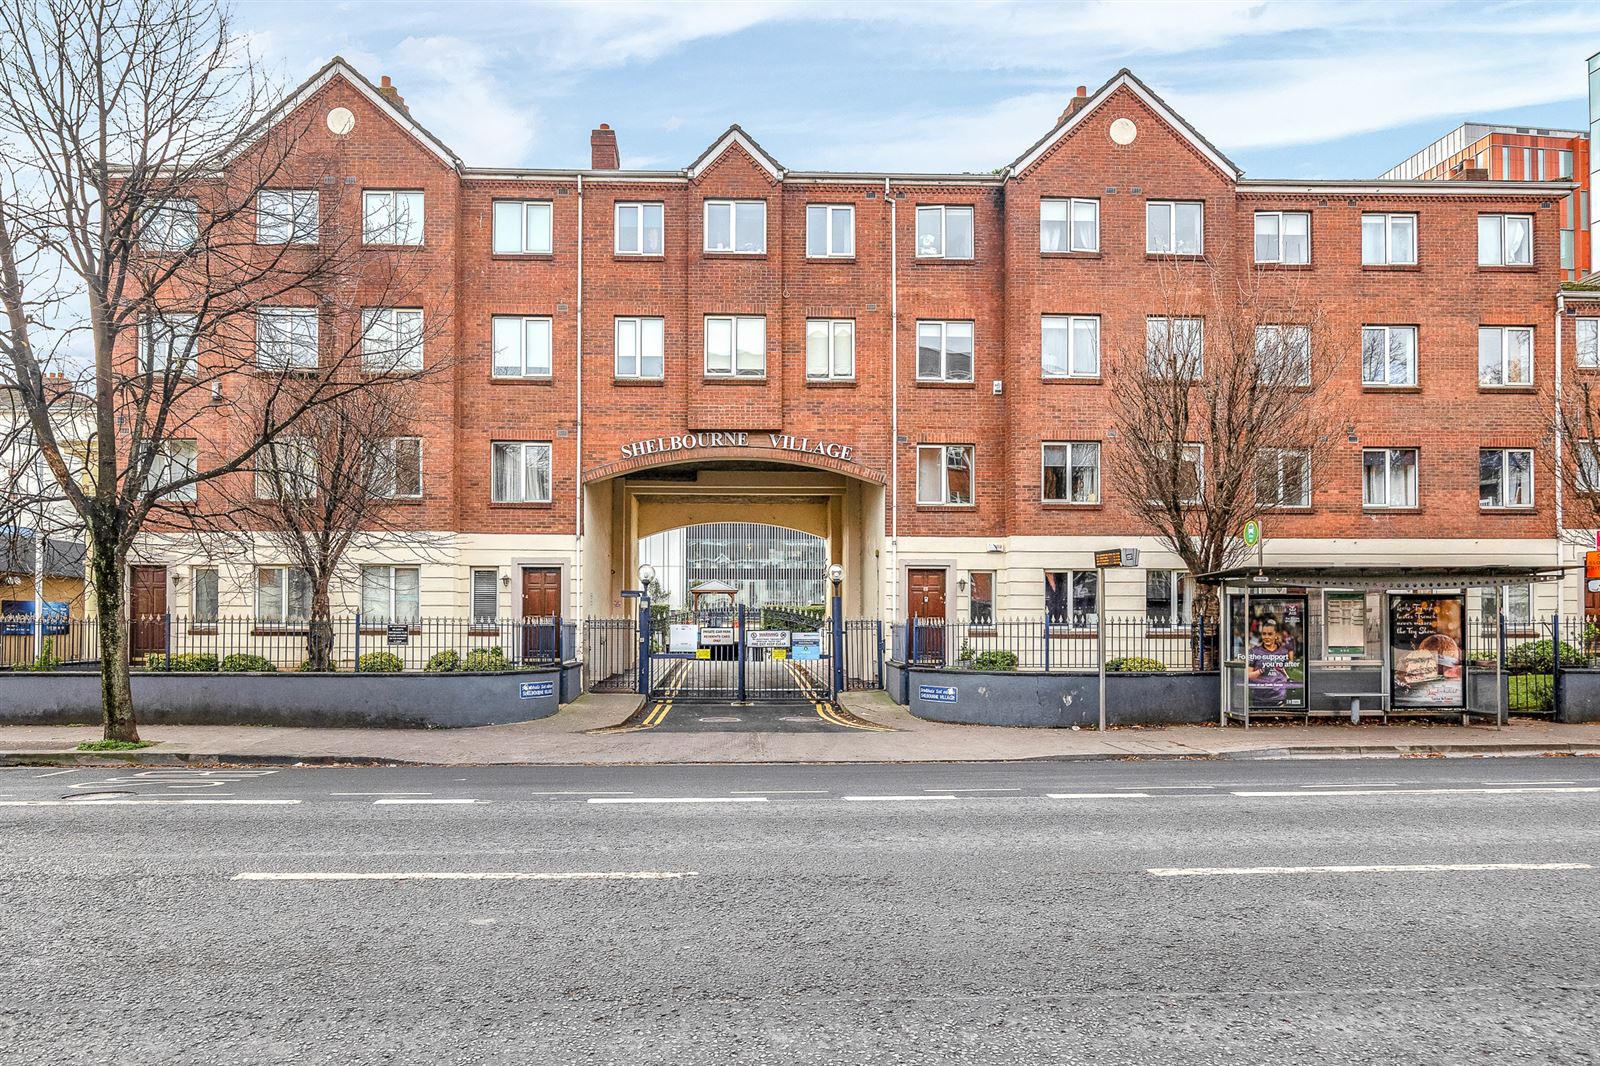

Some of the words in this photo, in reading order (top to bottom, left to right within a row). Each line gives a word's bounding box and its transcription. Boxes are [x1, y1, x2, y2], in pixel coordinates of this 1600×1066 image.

[621, 432, 749, 459] SHELBOURNE
[769, 433, 853, 461] VILLAGE
[1261, 653, 1289, 663] support
